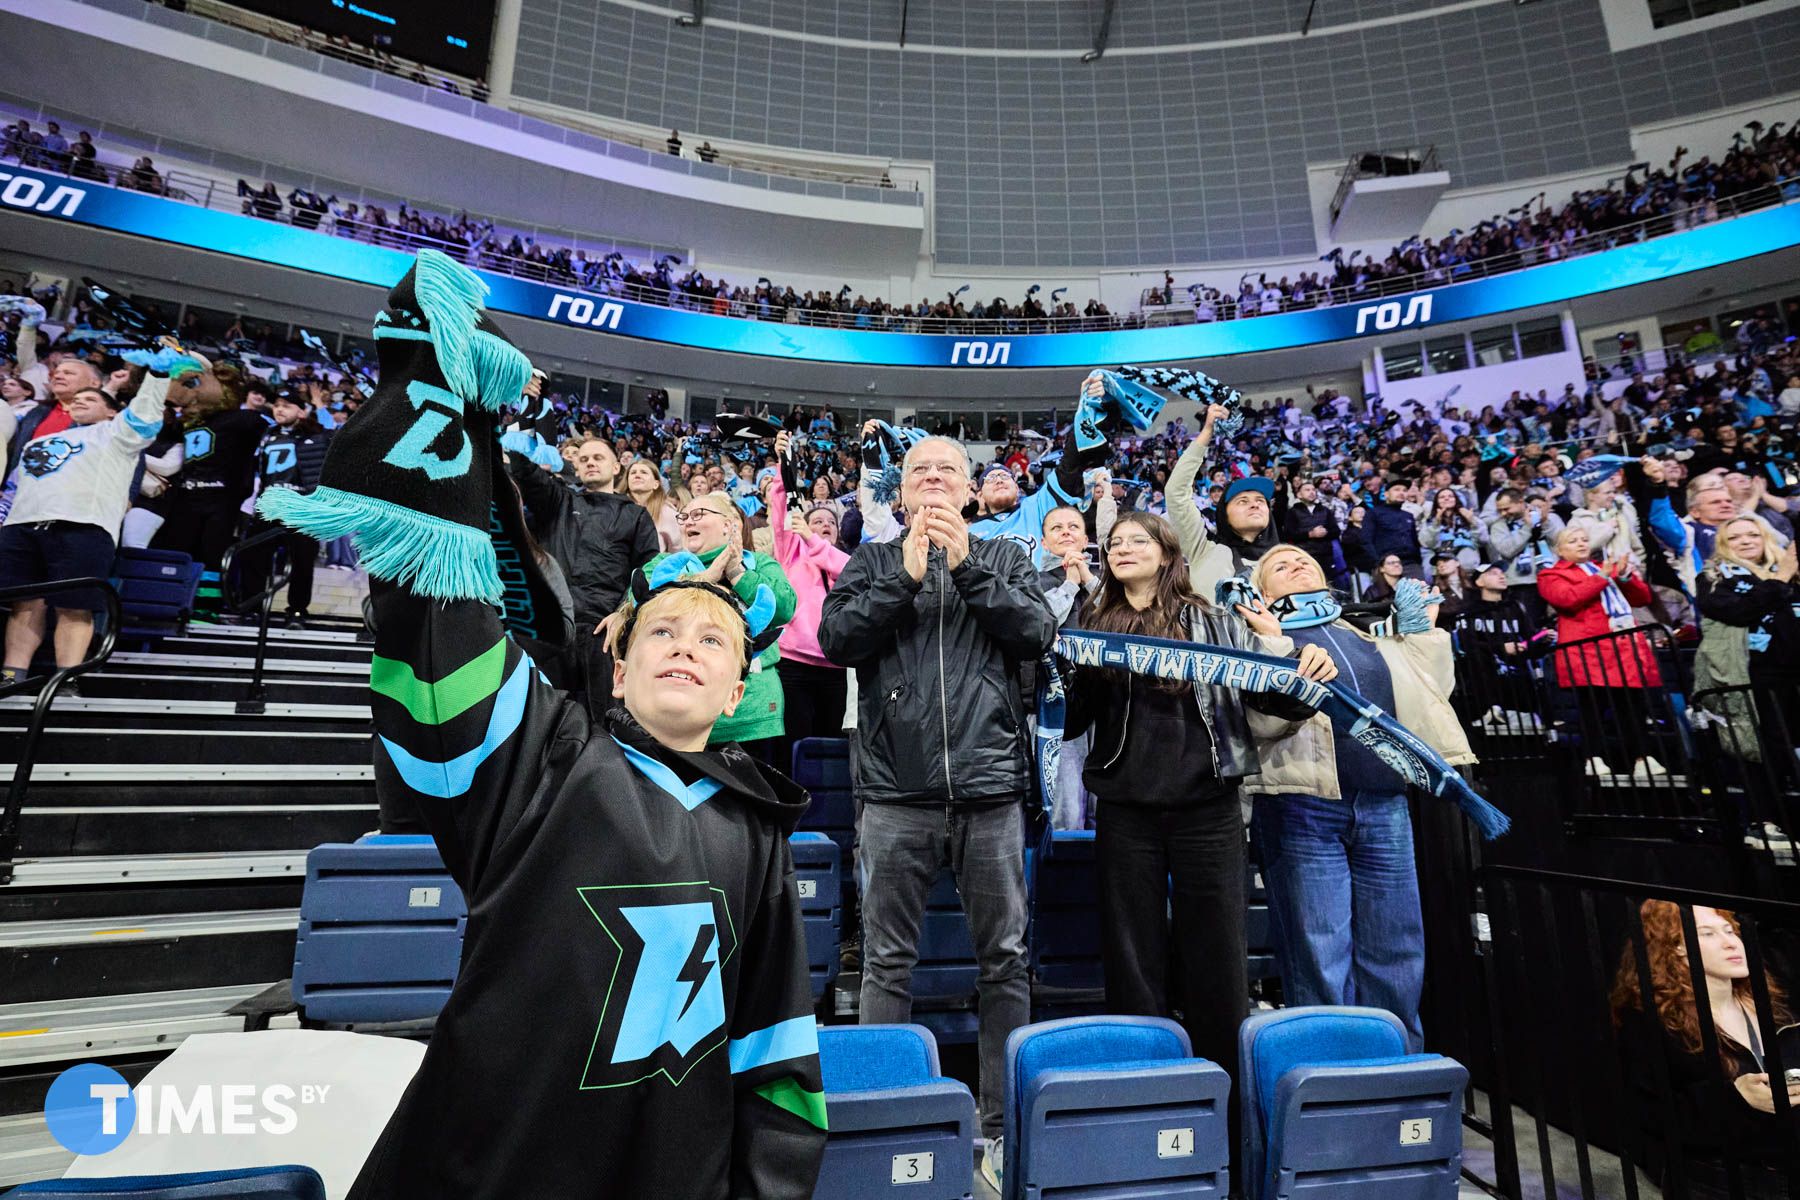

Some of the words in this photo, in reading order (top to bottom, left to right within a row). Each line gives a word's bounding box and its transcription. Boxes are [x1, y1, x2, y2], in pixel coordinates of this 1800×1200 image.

[547, 293, 625, 330] ГОЛ
[1355, 293, 1433, 334] ГОЛ
[950, 341, 1012, 365] ГОЛ
[423, 890, 428, 903] 1
[799, 883, 807, 895] 3
[1411, 1123, 1421, 1140] 5
[1171, 1133, 1181, 1152] 4
[907, 1158, 919, 1178] 3
